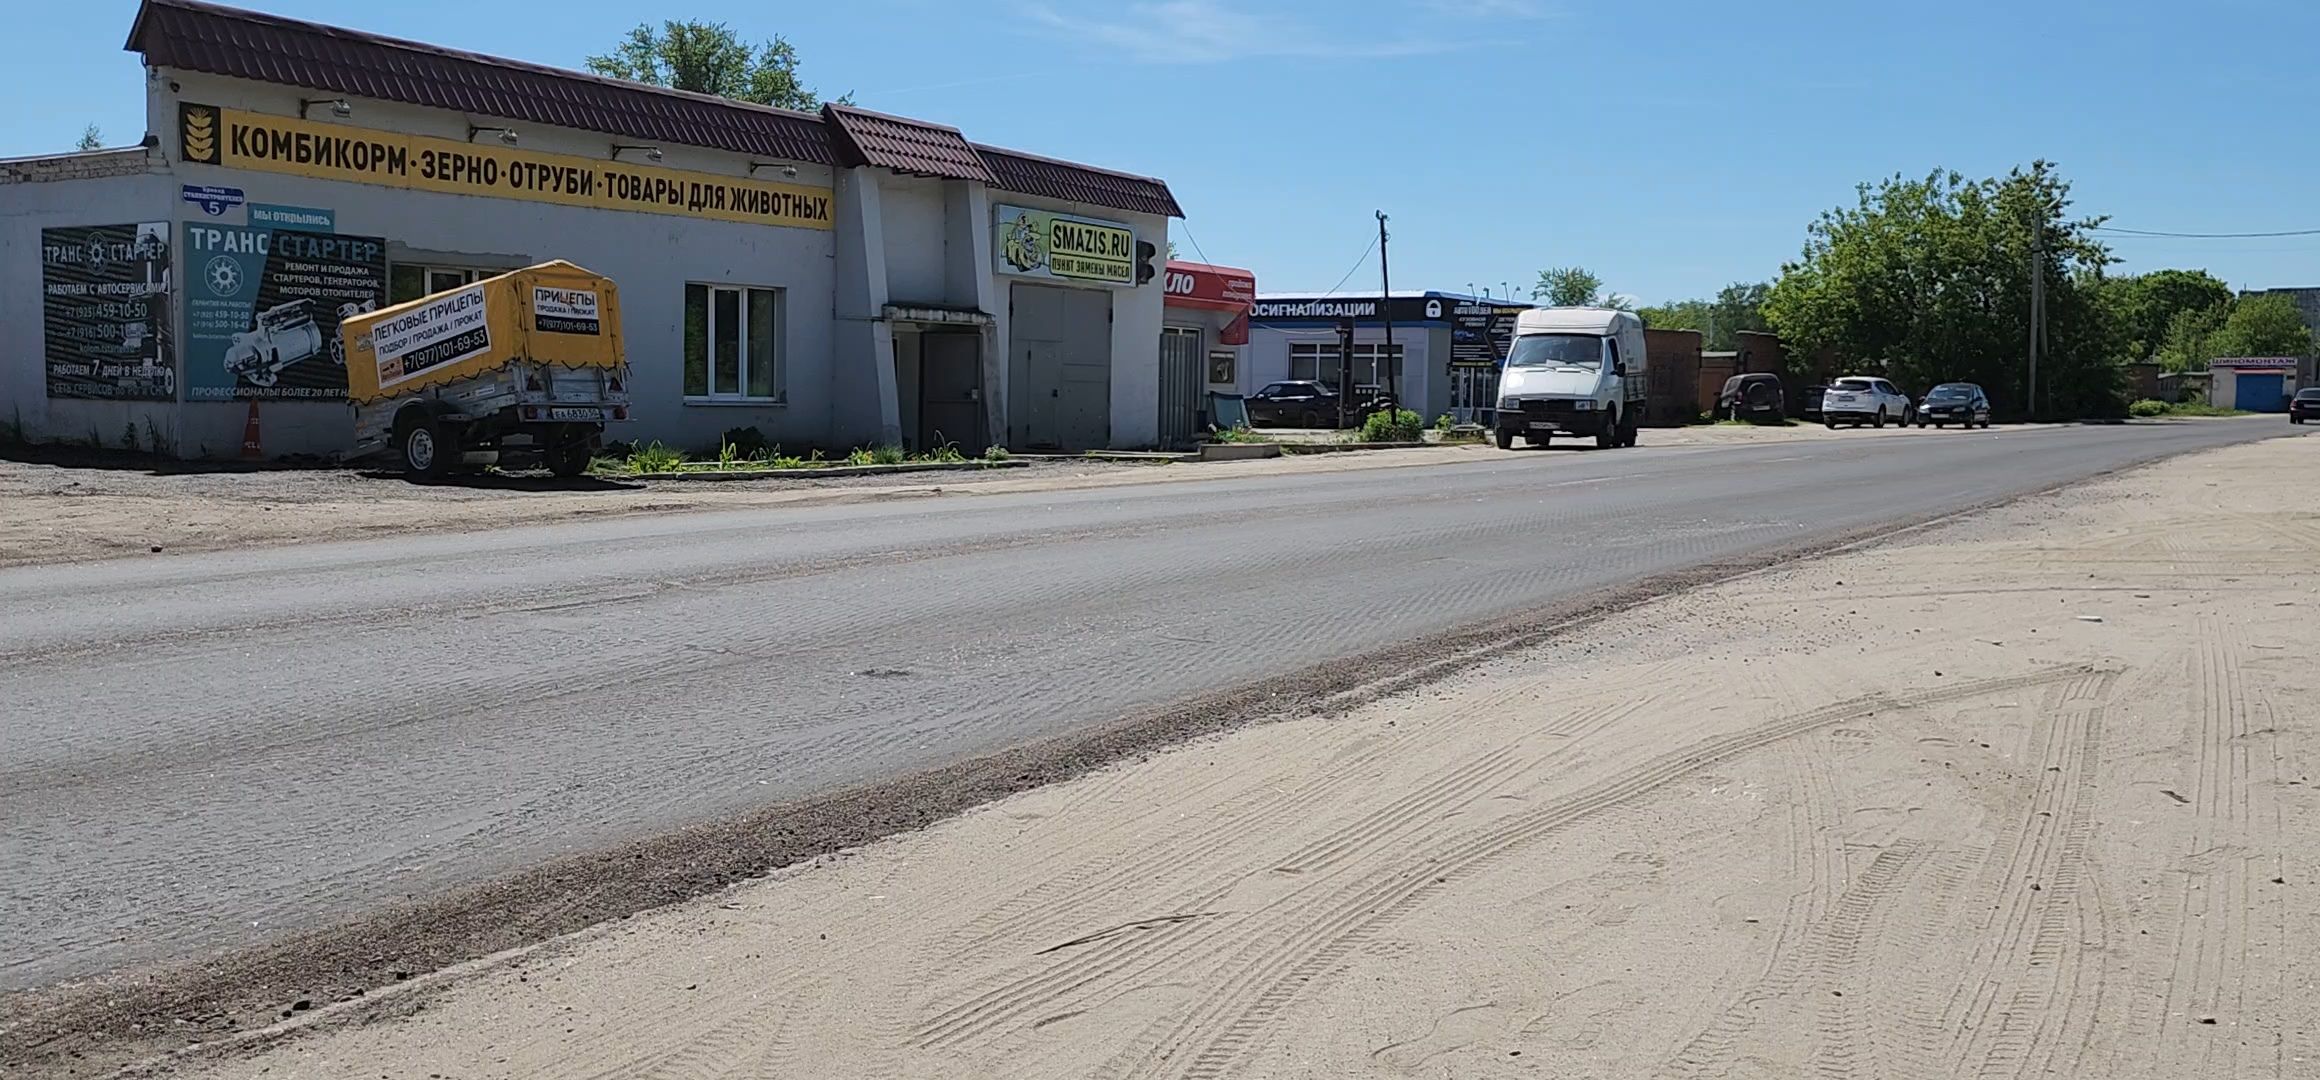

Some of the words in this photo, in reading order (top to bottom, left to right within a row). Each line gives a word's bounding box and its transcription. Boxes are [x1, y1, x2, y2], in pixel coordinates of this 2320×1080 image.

[231, 123, 407, 176] КОМБИКОРМ
[421, 149, 498, 186] ЗЕРНО
[509, 160, 593, 197] ОТРУБИ
[604, 172, 684, 206] ТОВАРЫ
[688, 182, 725, 212] ДЛЯ
[729, 186, 828, 221] ЖИВОТНЫХ
[209, 201, 220, 215] 5
[254, 209, 271, 220] МЫ
[273, 211, 330, 226] ОТКРЫЛИСЬ
[190, 227, 268, 255] ТРАНС
[279, 235, 378, 262] СТАРТЕР
[1053, 224, 1130, 258] SMAZIS.RU
[45, 246, 82, 262] ТРАНС
[111, 243, 164, 261] СТАРТЕР
[285, 262, 319, 273] РЕМОНТ
[320, 264, 327, 273] И
[328, 265, 369, 276] ПРОДАЖА
[1052, 258, 1074, 271] ПУНКТ
[1076, 261, 1104, 275] ЗАМЕНЫ
[1107, 264, 1129, 278] МАСЕЛ
[48, 284, 87, 295] РАБОТАЕМ
[89, 284, 95, 294] С
[97, 282, 166, 294] АВТОСЕРВИСАМИ
[273, 273, 323, 285] СТАРТЕРОВ,
[323, 276, 380, 288] ГЕНЕРАТОРОВ,
[280, 286, 321, 296] МОТОРОВ
[322, 289, 375, 299] ОТОПИТЕЛЕЙ
[535, 289, 595, 306] ПРИЦЕПЫ
[374, 310, 427, 341] ЛЕГКОВЫЕ
[429, 290, 483, 320] ПРИЦЕПЫ
[537, 304, 566, 313] ПРОДАЖА
[1249, 303, 1376, 317] ОСИГНАЛИЗАЦИИ
[379, 337, 409, 356] ПОДБОР
[413, 323, 448, 344] ПРОДАЖА
[454, 310, 482, 329] ПРОКАТ
[404, 330, 486, 369] +7(977)101-69-53
[53, 364, 89, 376] РАБОТАЕМ
[92, 360, 100, 376] 7
[102, 364, 121, 378] ДНЕЙ
[124, 366, 130, 376] В
[281, 387, 310, 397] БОЛЕЕ
[311, 388, 322, 397] 20
[323, 388, 340, 397] ЛЕТ
